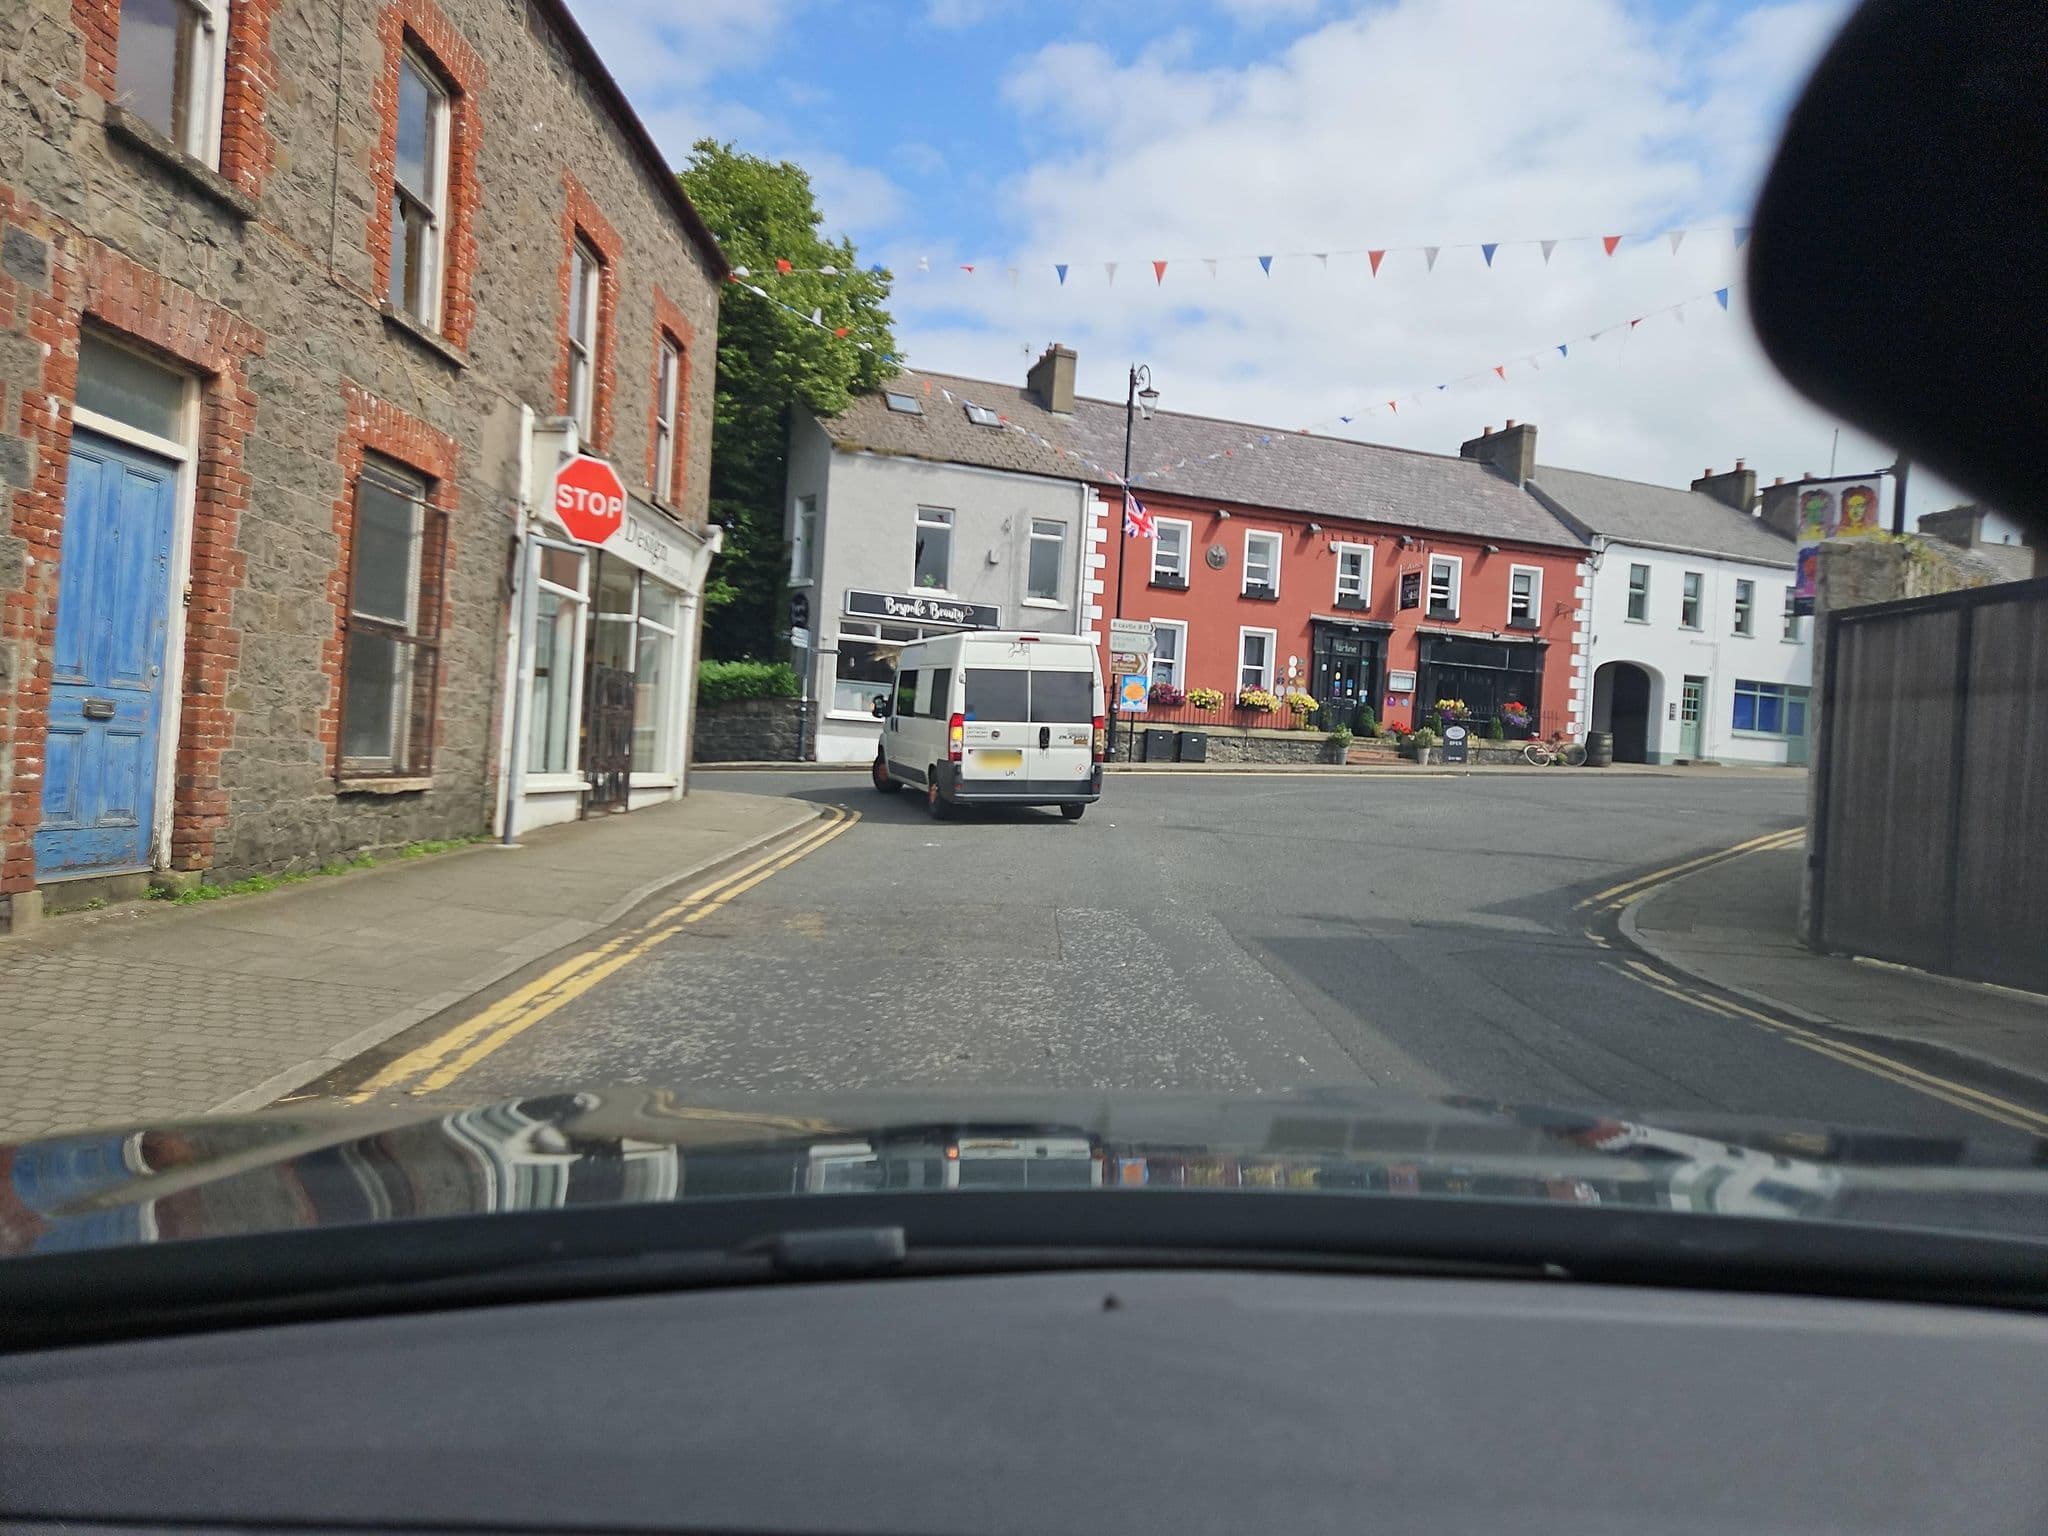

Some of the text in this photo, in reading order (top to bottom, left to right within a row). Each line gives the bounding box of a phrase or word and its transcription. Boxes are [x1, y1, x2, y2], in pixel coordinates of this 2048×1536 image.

[557, 484, 622, 518] STOP
[624, 516, 667, 565] Design
[884, 597, 964, 623] Bespoke Beauty
